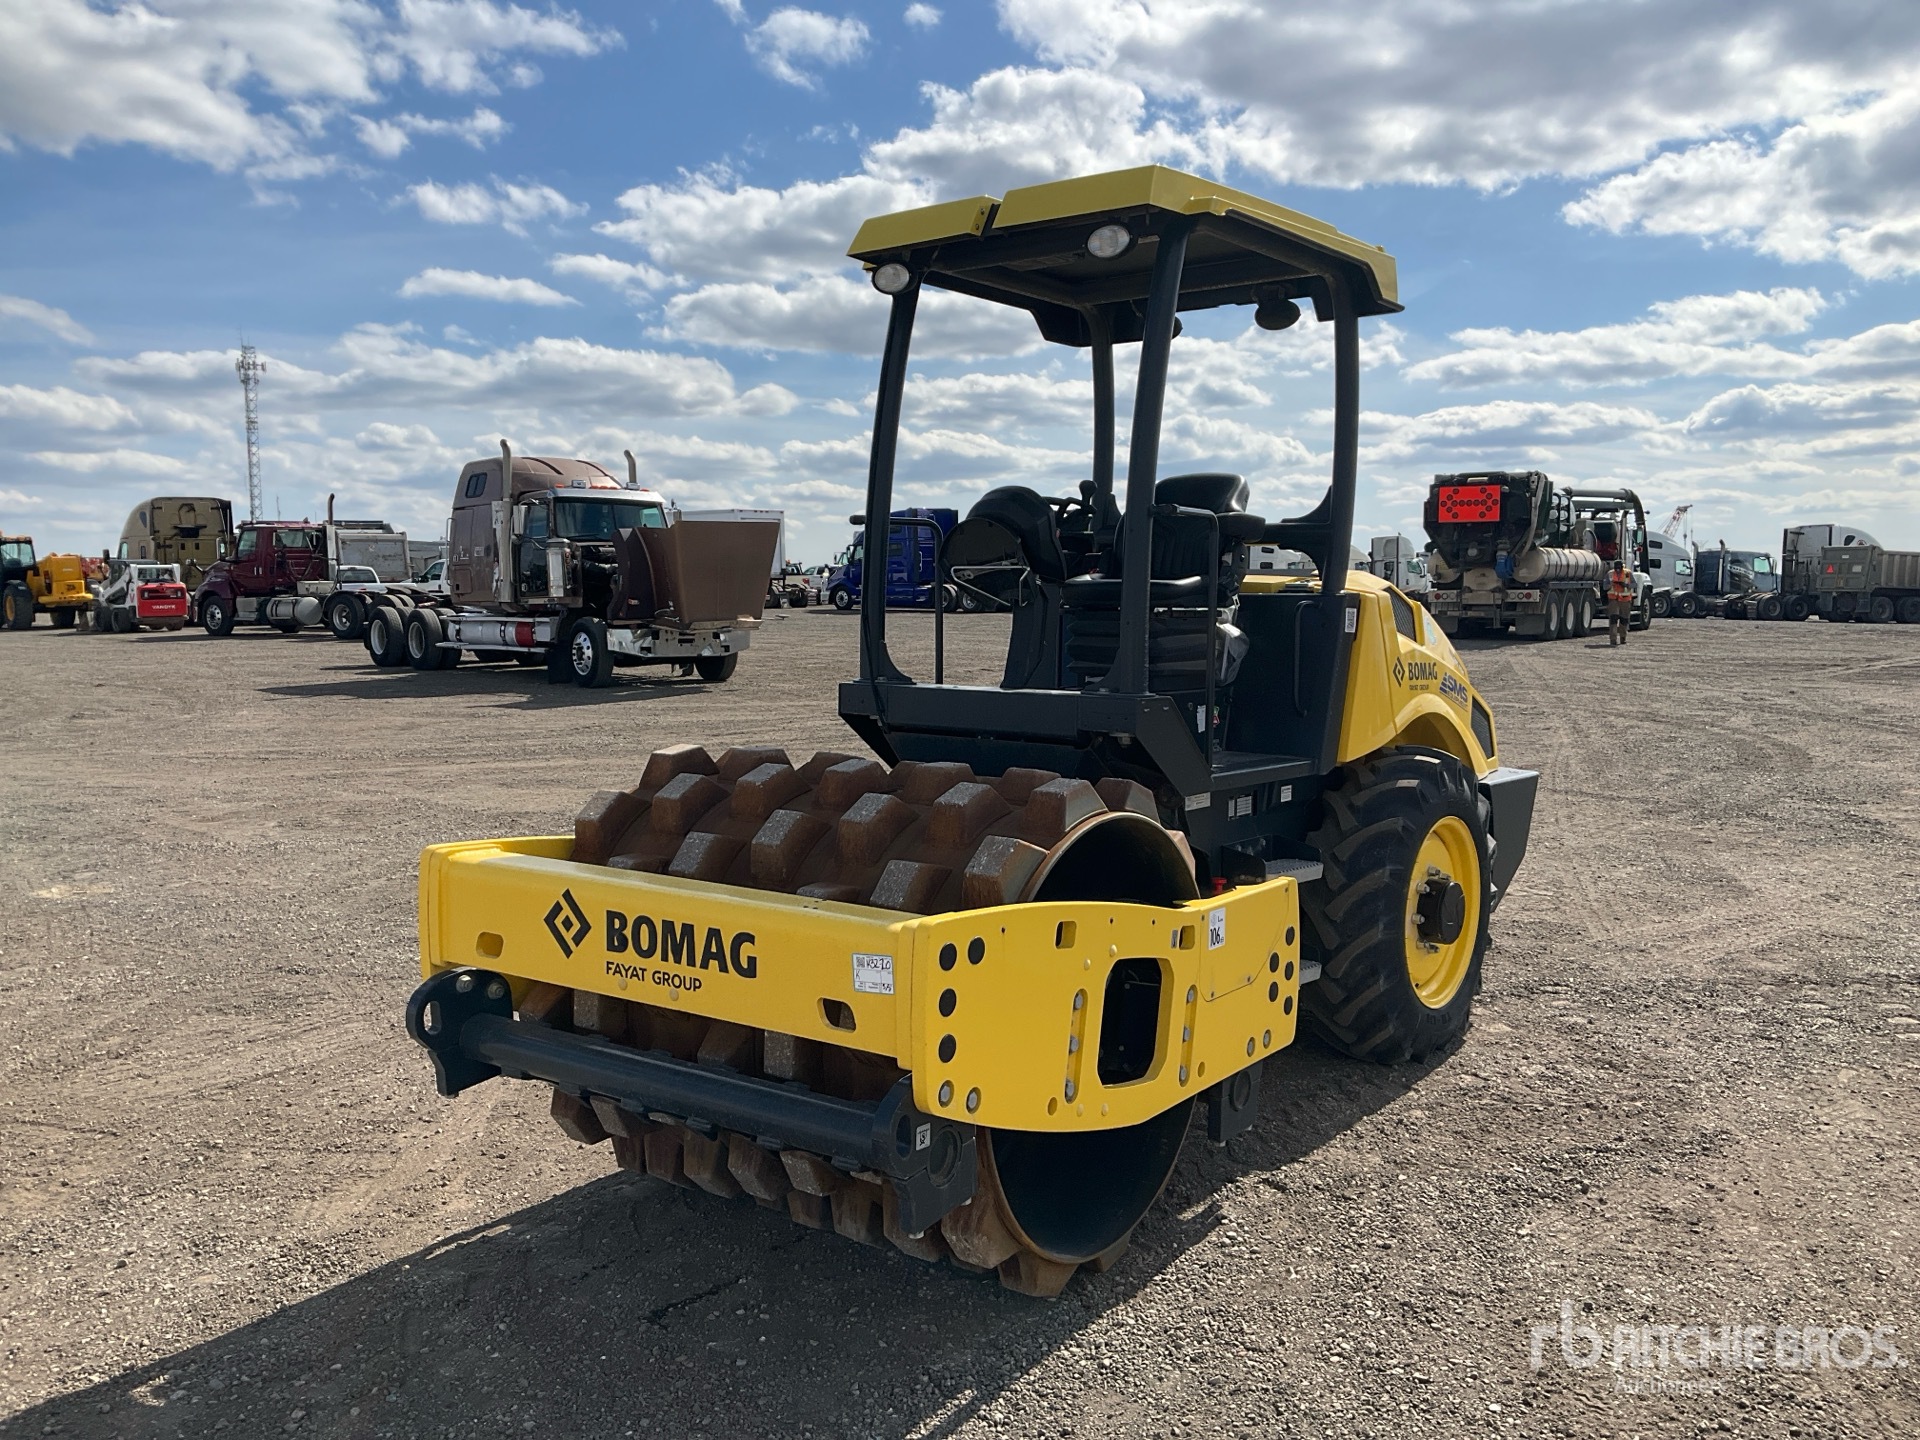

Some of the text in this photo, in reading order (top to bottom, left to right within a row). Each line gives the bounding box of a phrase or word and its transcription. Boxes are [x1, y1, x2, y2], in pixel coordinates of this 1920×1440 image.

[1408, 662, 1438, 681] BOMAG
[1447, 674, 1468, 703] SMS
[605, 909, 758, 979] BOMAG
[1210, 927, 1220, 947] 106
[605, 960, 703, 992] FAYAT GROUP
